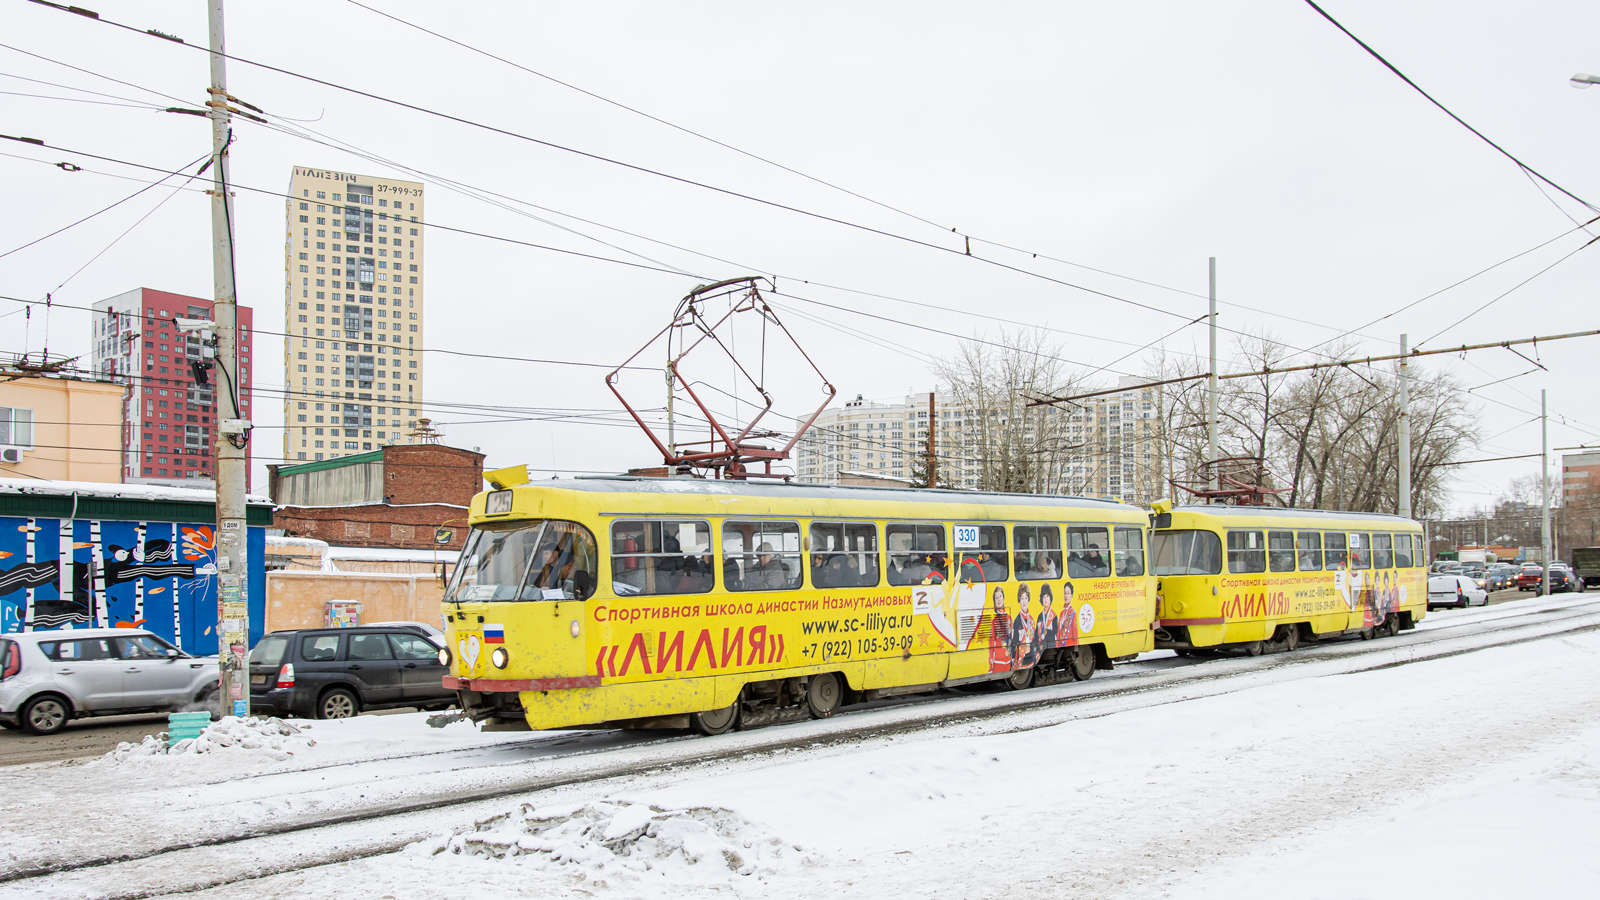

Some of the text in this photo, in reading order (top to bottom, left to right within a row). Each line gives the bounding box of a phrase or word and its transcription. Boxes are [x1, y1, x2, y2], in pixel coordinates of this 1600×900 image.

[377, 184, 423, 198] 37-999-37
[493, 492, 510, 513] 25
[958, 528, 976, 541] 330
[1221, 578, 1260, 589] Спортивная
[1262, 578, 1279, 586] школа
[1280, 577, 1301, 585] династии
[1078, 589, 1122, 602] ХУДОЖЕСТВЕННОЙ
[1221, 592, 1290, 618] «ЛИЛИЯ»
[594, 594, 912, 624] Спортивная школа династии Назмутдиновых
[802, 612, 913, 635] www.sc-liliya.ru
[595, 625, 785, 678] «ЛИЛИЯ»
[802, 634, 913, 661] +7 (922) 105-39-09
